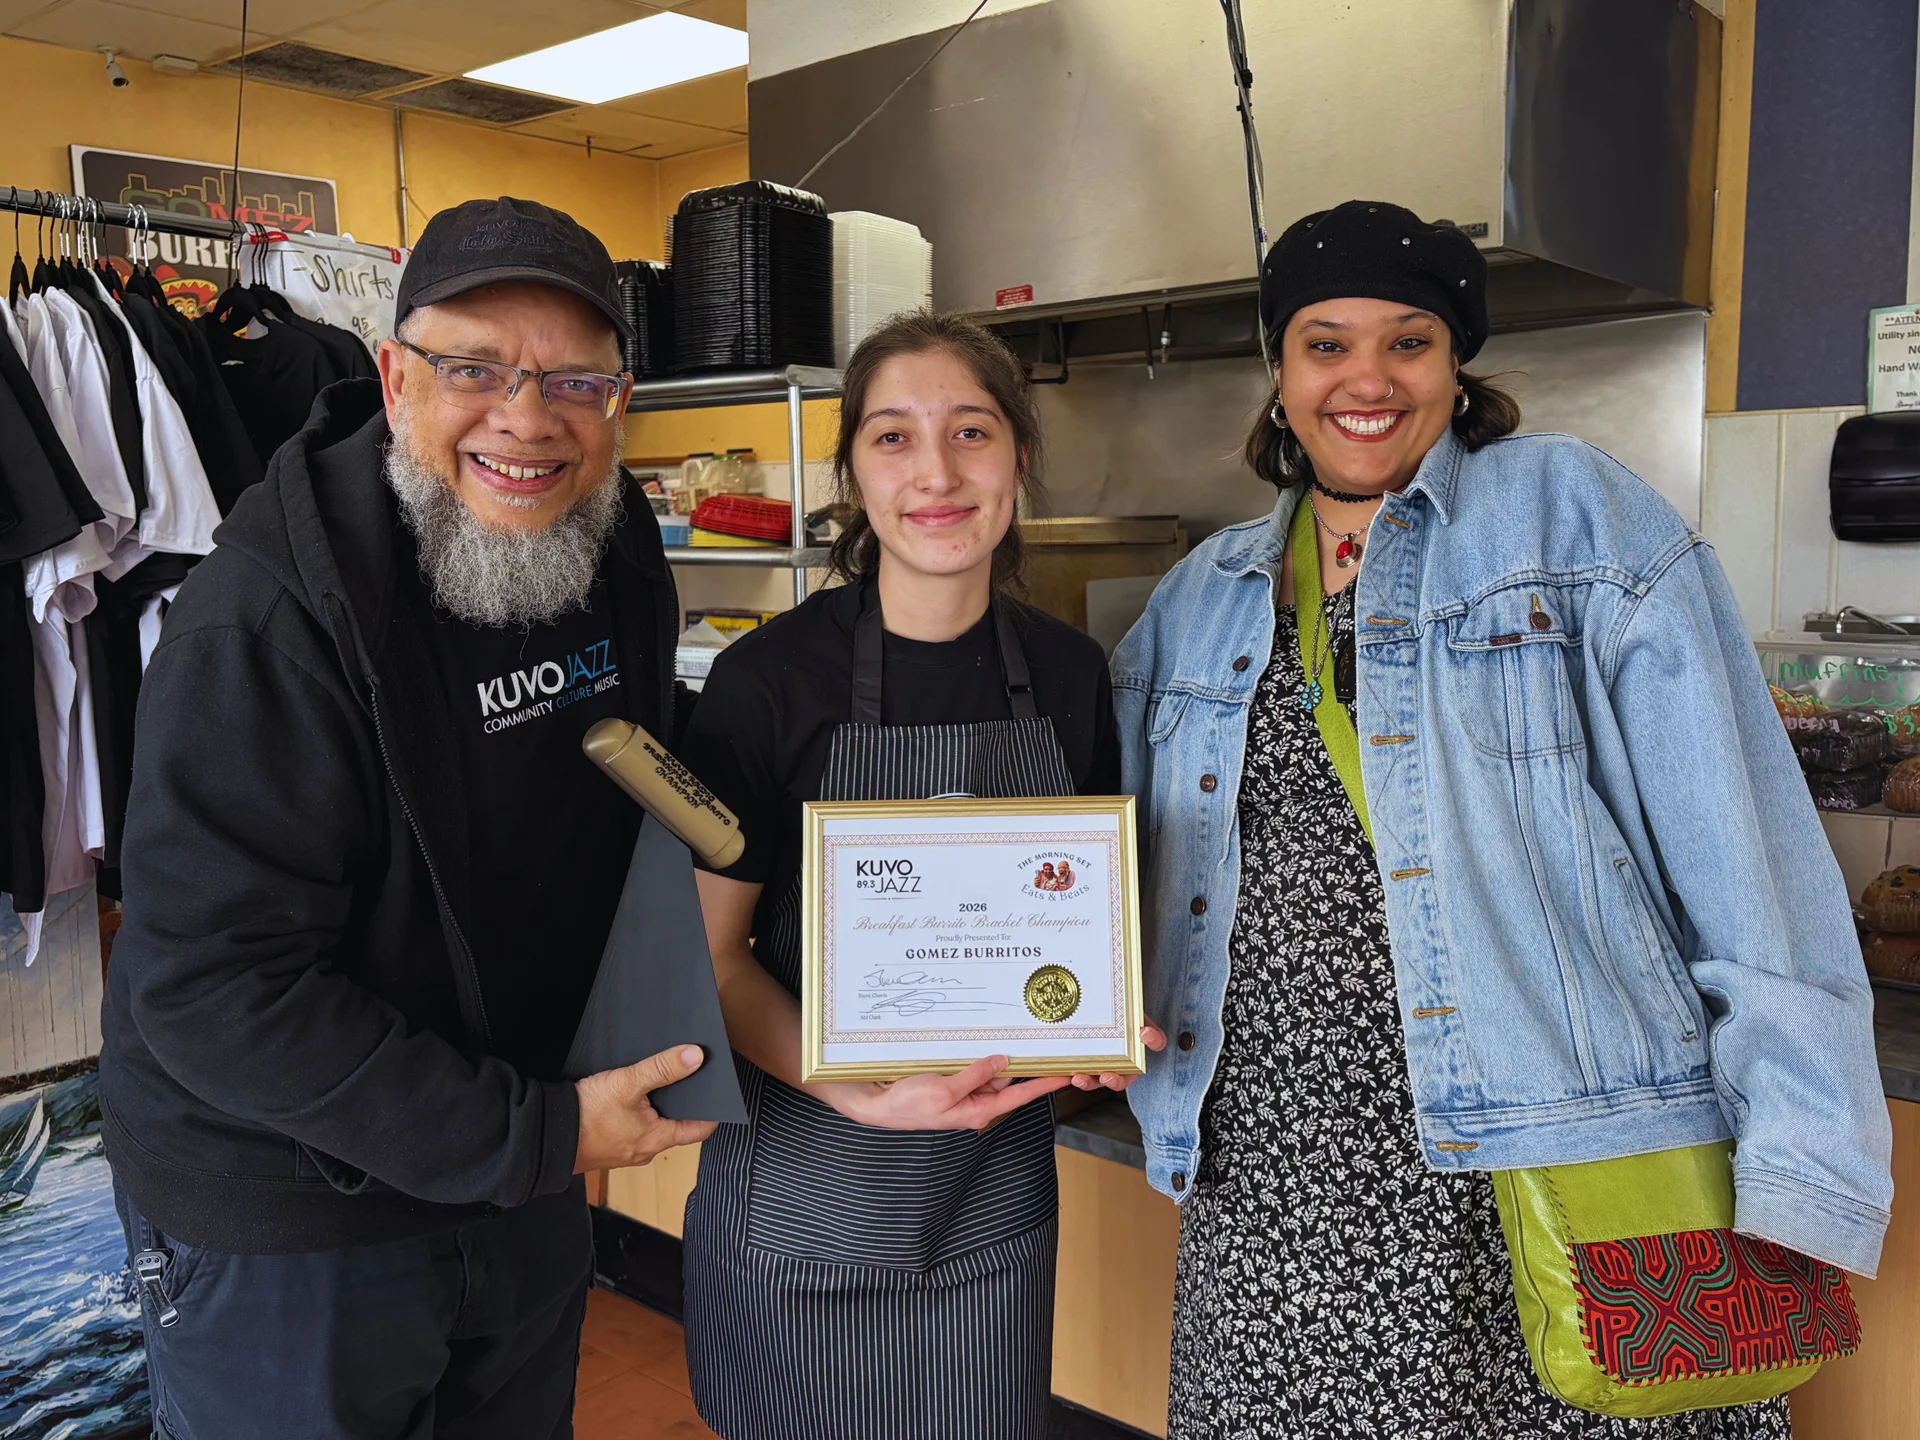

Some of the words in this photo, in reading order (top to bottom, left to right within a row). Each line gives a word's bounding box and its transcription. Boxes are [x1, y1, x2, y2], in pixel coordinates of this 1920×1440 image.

[1878, 331, 1905, 340] Utility
[1879, 363, 1905, 373] Hand
[1896, 390, 1917, 398] Thank
[484, 699, 553, 734] COMMUNITY
[556, 684, 593, 709] CULTURE
[594, 673, 620, 695] MUSIC
[664, 752, 689, 777] KUVO
[688, 774, 716, 803] RADIO
[655, 766, 701, 809] CHAMPION
[856, 859, 913, 876] KUVO
[1016, 856, 1034, 870] THE
[1034, 851, 1075, 861] MORNING
[1075, 856, 1092, 869] SET
[856, 880, 876, 889] 89.3
[874, 876, 922, 893] JAZZ
[1021, 883, 1045, 900] Eats
[1047, 892, 1057, 902] &
[1059, 884, 1090, 901] Beats
[958, 903, 987, 913] 2026
[852, 914, 919, 936] Breakfast
[919, 914, 967, 930] Burrito
[970, 912, 1024, 929] Bracket
[1026, 911, 1092, 933] Champion
[935, 934, 963, 943] Proudly
[964, 933, 999, 941] Presented
[1000, 933, 1012, 941] To:
[905, 948, 960, 960] GOMEZ
[964, 946, 1042, 959] BURRITOS
